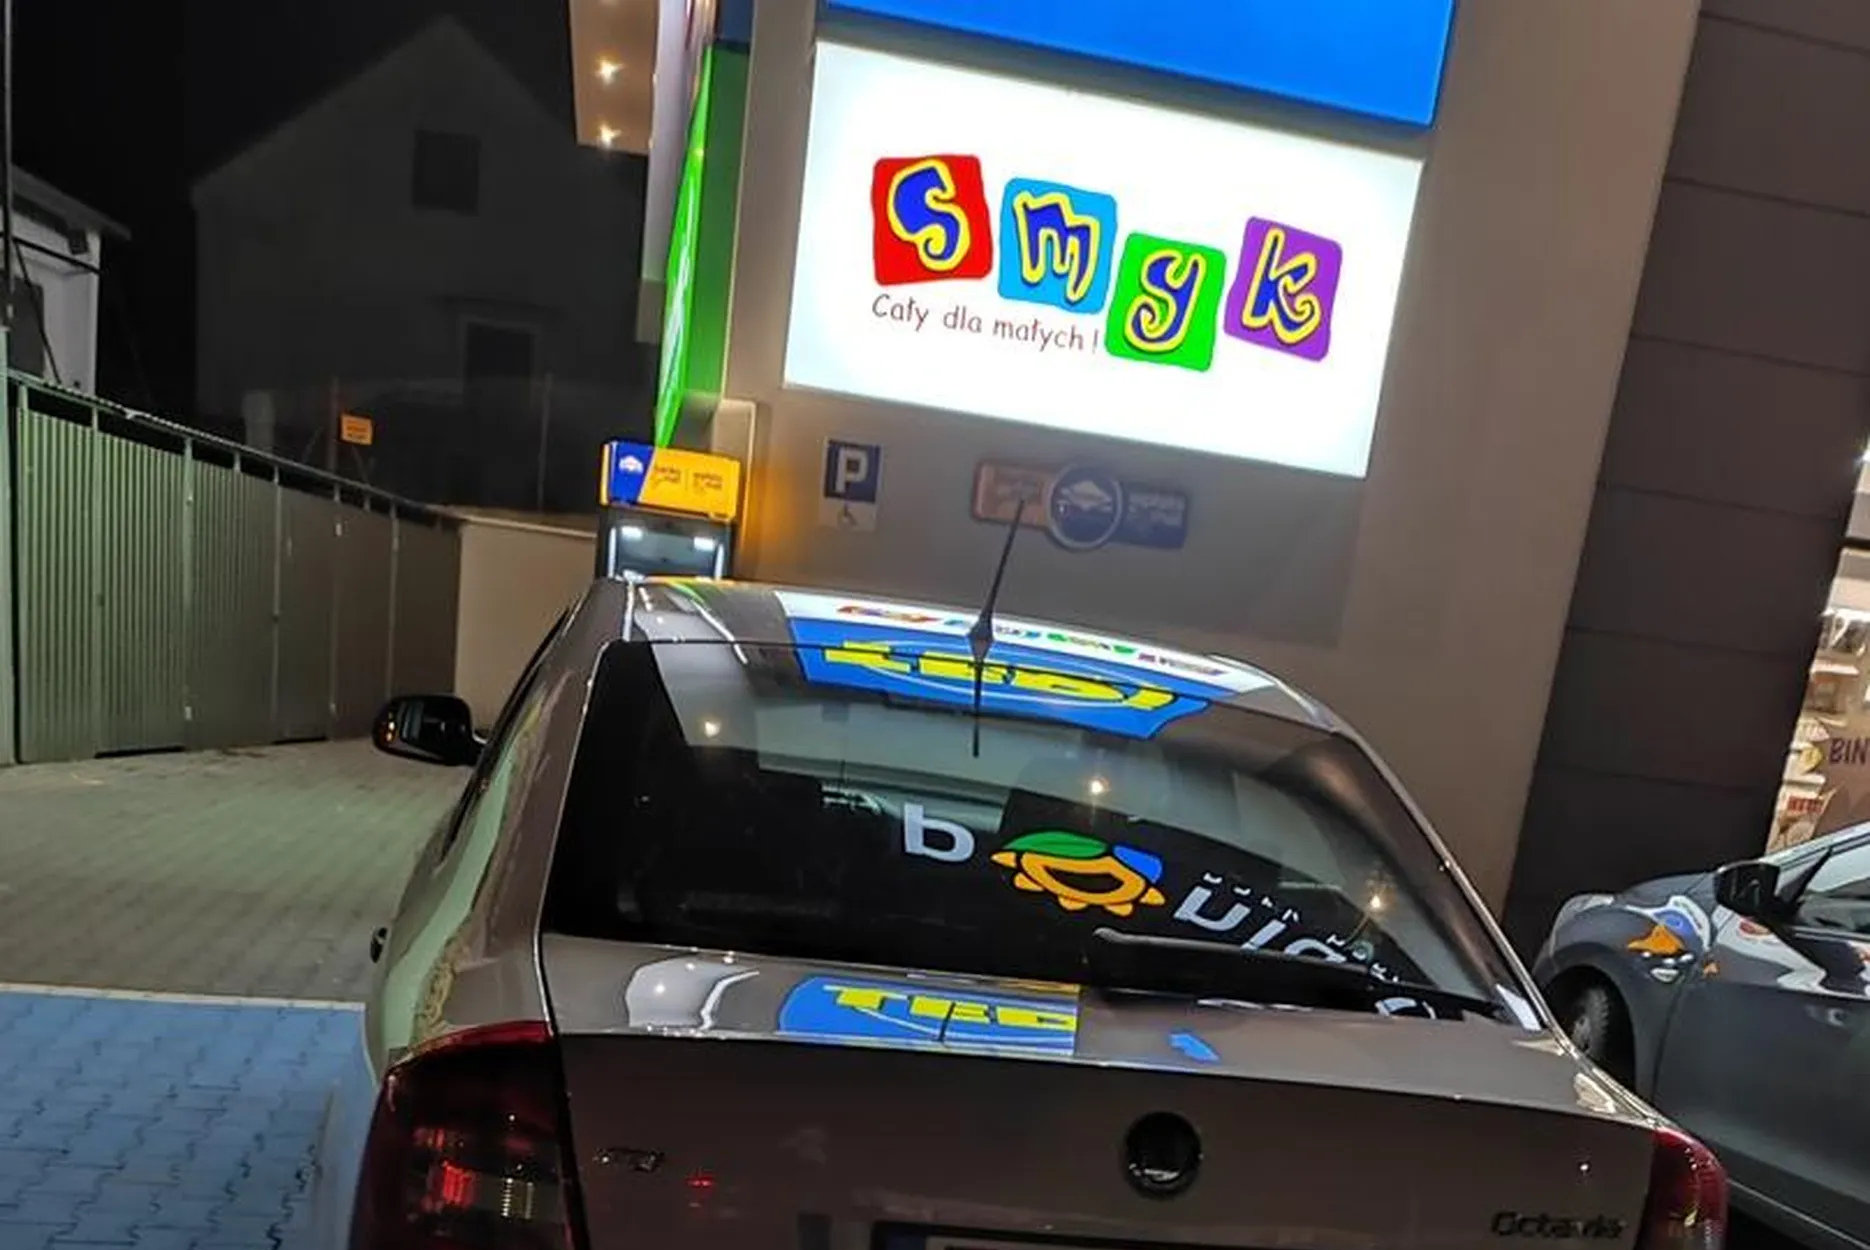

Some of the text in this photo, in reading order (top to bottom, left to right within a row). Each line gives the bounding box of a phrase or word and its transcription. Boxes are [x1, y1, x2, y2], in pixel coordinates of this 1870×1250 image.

[872, 293, 929, 331] Cały
[943, 305, 982, 333] dla
[833, 446, 868, 492] P
